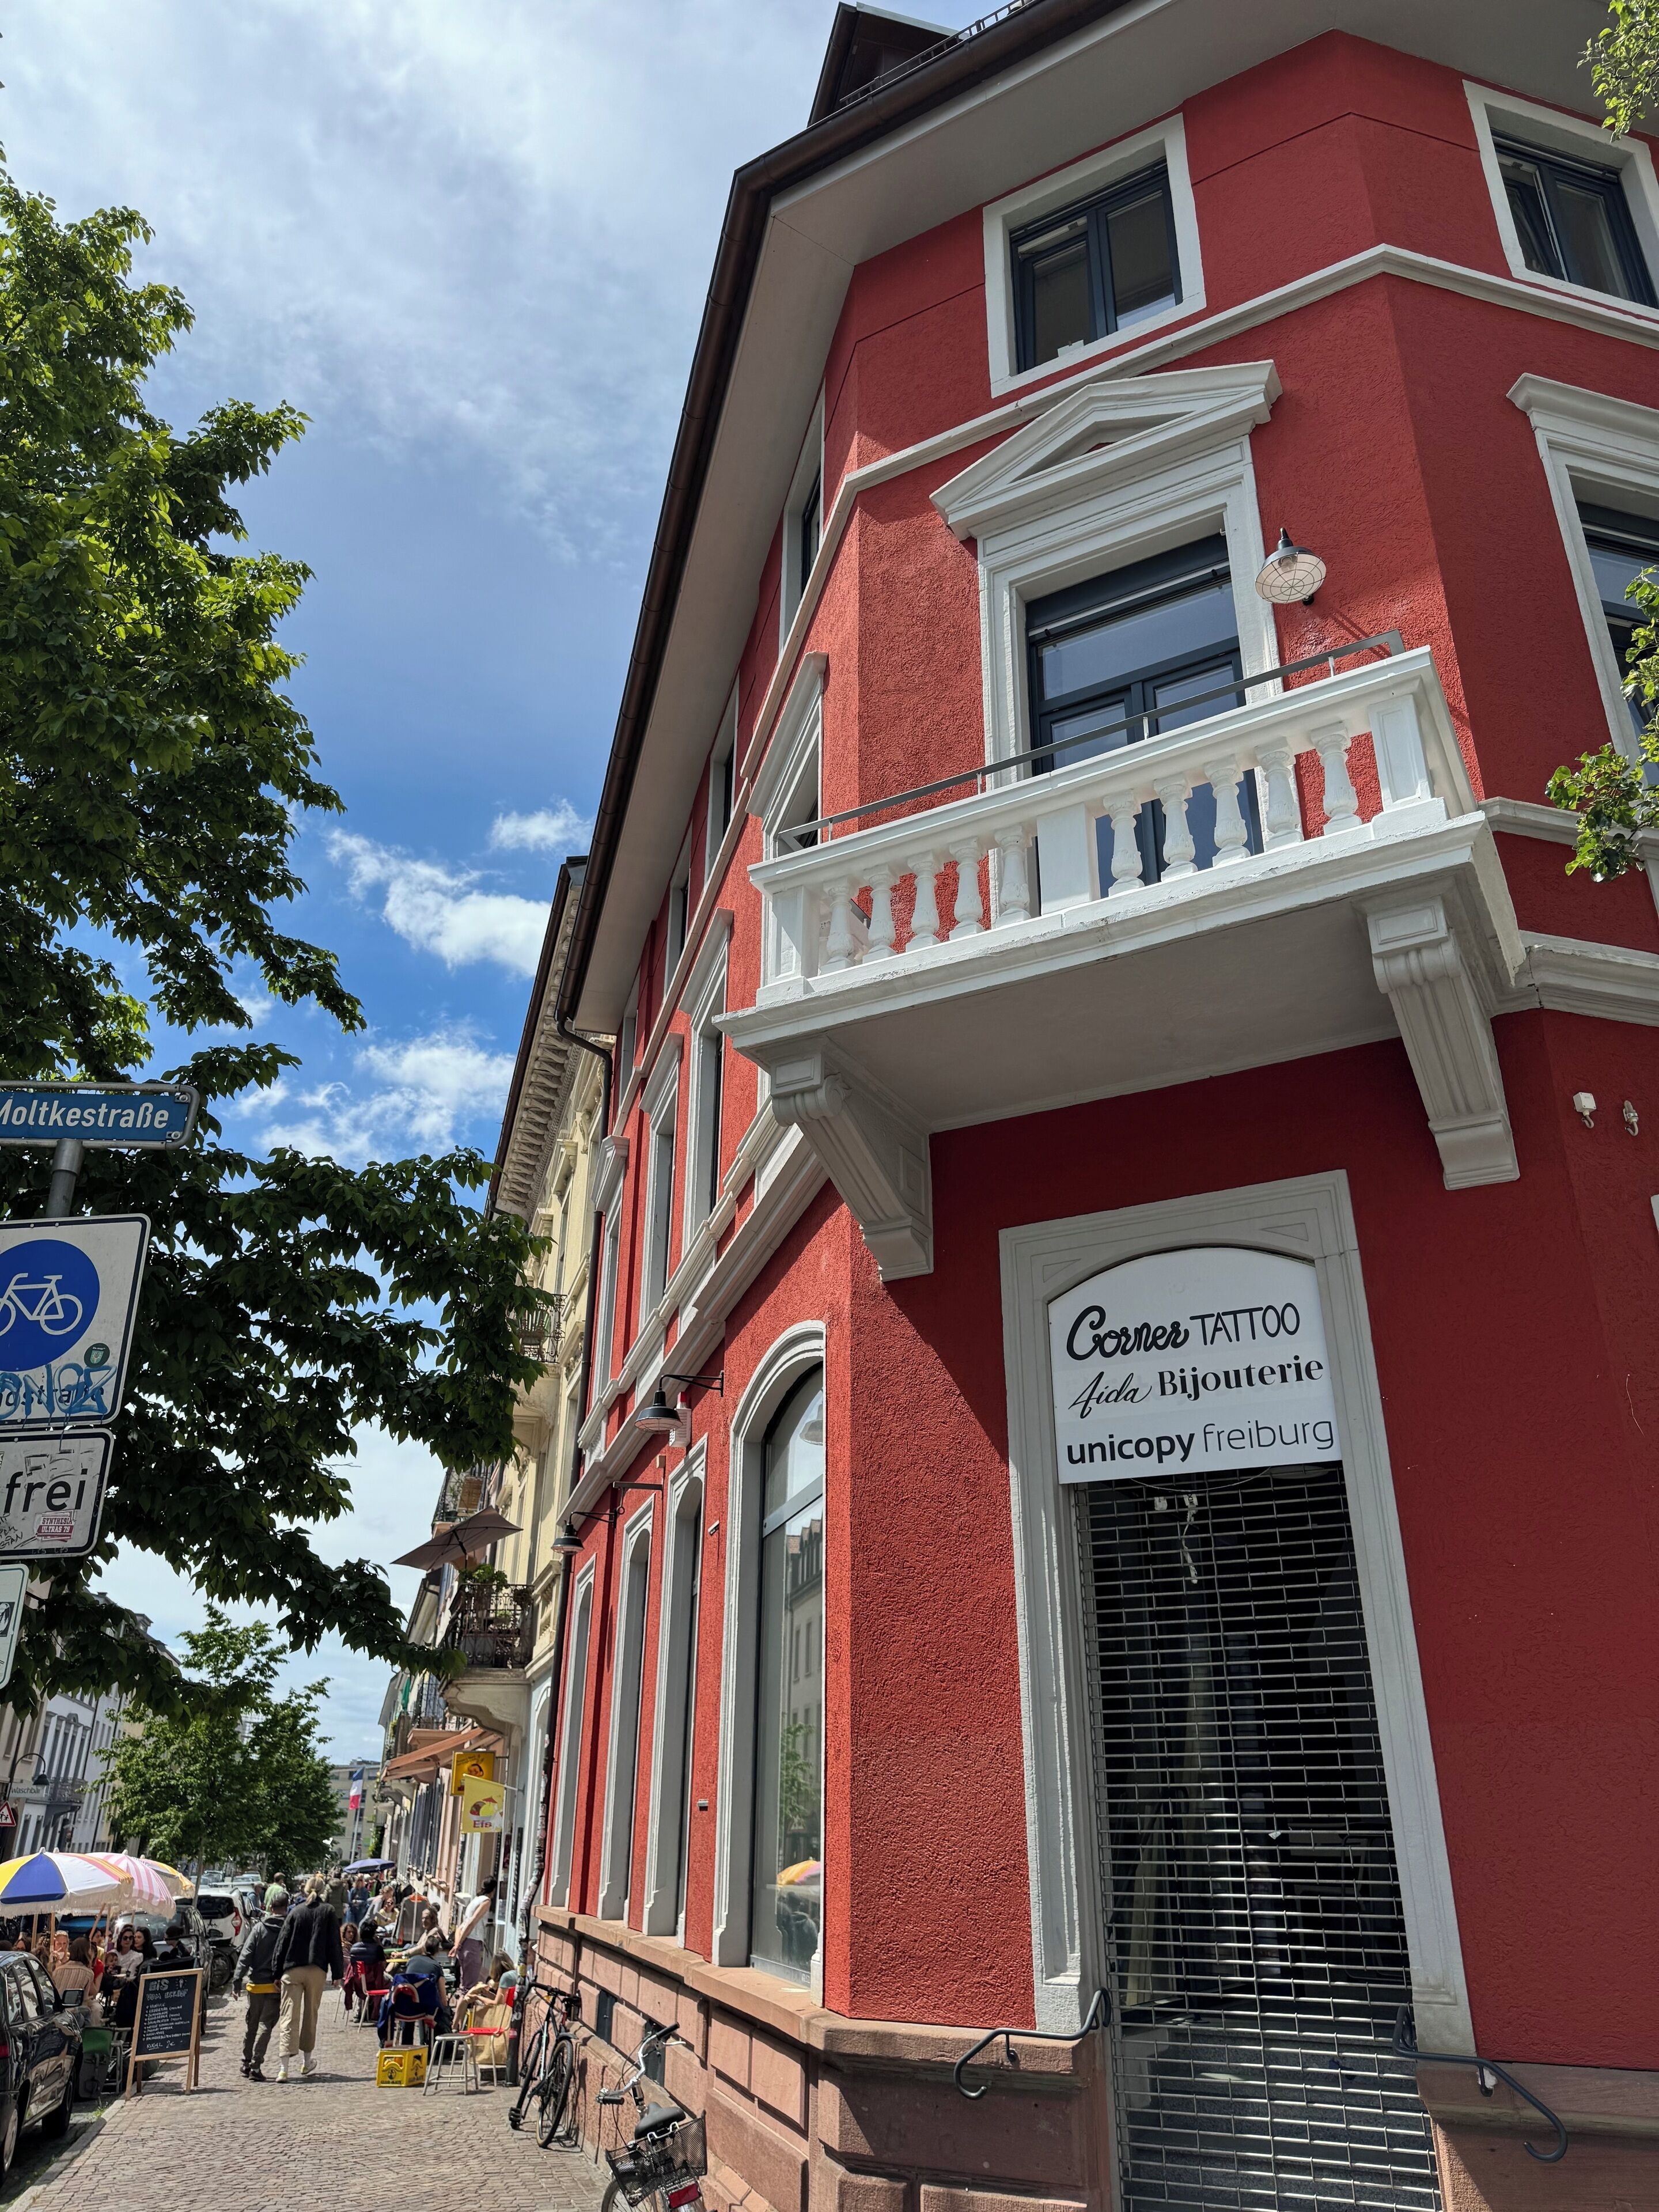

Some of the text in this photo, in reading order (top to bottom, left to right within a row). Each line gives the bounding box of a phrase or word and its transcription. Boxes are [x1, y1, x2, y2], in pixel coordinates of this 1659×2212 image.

[1066, 1302, 1300, 1361] Corner TATTOO
[1068, 1355, 1324, 1419] Aida Bijouterie
[1067, 1420, 1334, 1464] unicopy freiburg
[3, 1468, 88, 1513] frei
